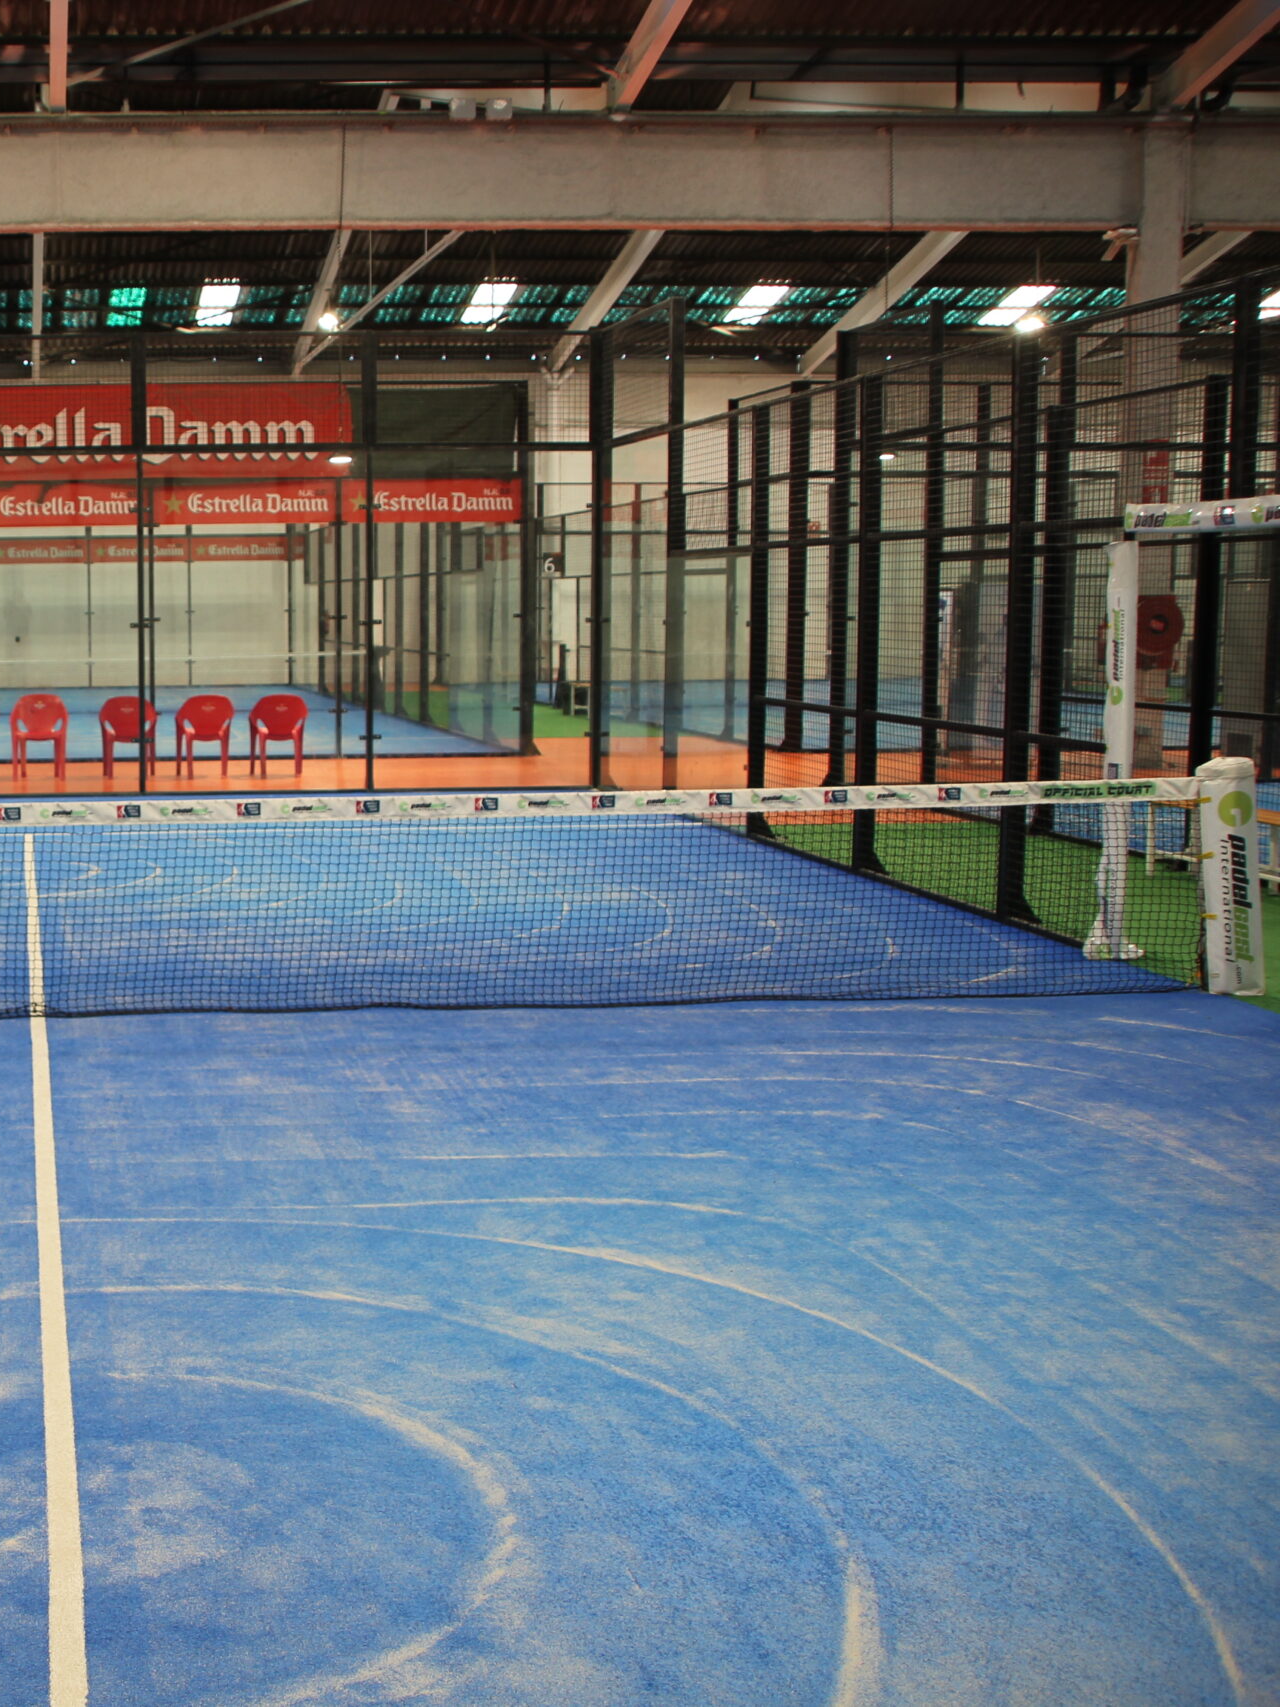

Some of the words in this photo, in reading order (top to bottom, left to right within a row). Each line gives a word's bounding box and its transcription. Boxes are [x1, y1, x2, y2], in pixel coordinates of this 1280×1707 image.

[133, 405, 319, 465] Damm
[0, 494, 75, 517] Estrella
[187, 491, 263, 514] Estrella
[266, 492, 329, 514] Damm
[373, 490, 449, 513] Estrella
[451, 491, 513, 513] Damm
[544, 557, 556, 573] 6
[1043, 786, 1104, 799] OFFICIAL
[1106, 784, 1153, 797] COURT
[1219, 839, 1236, 963] International
